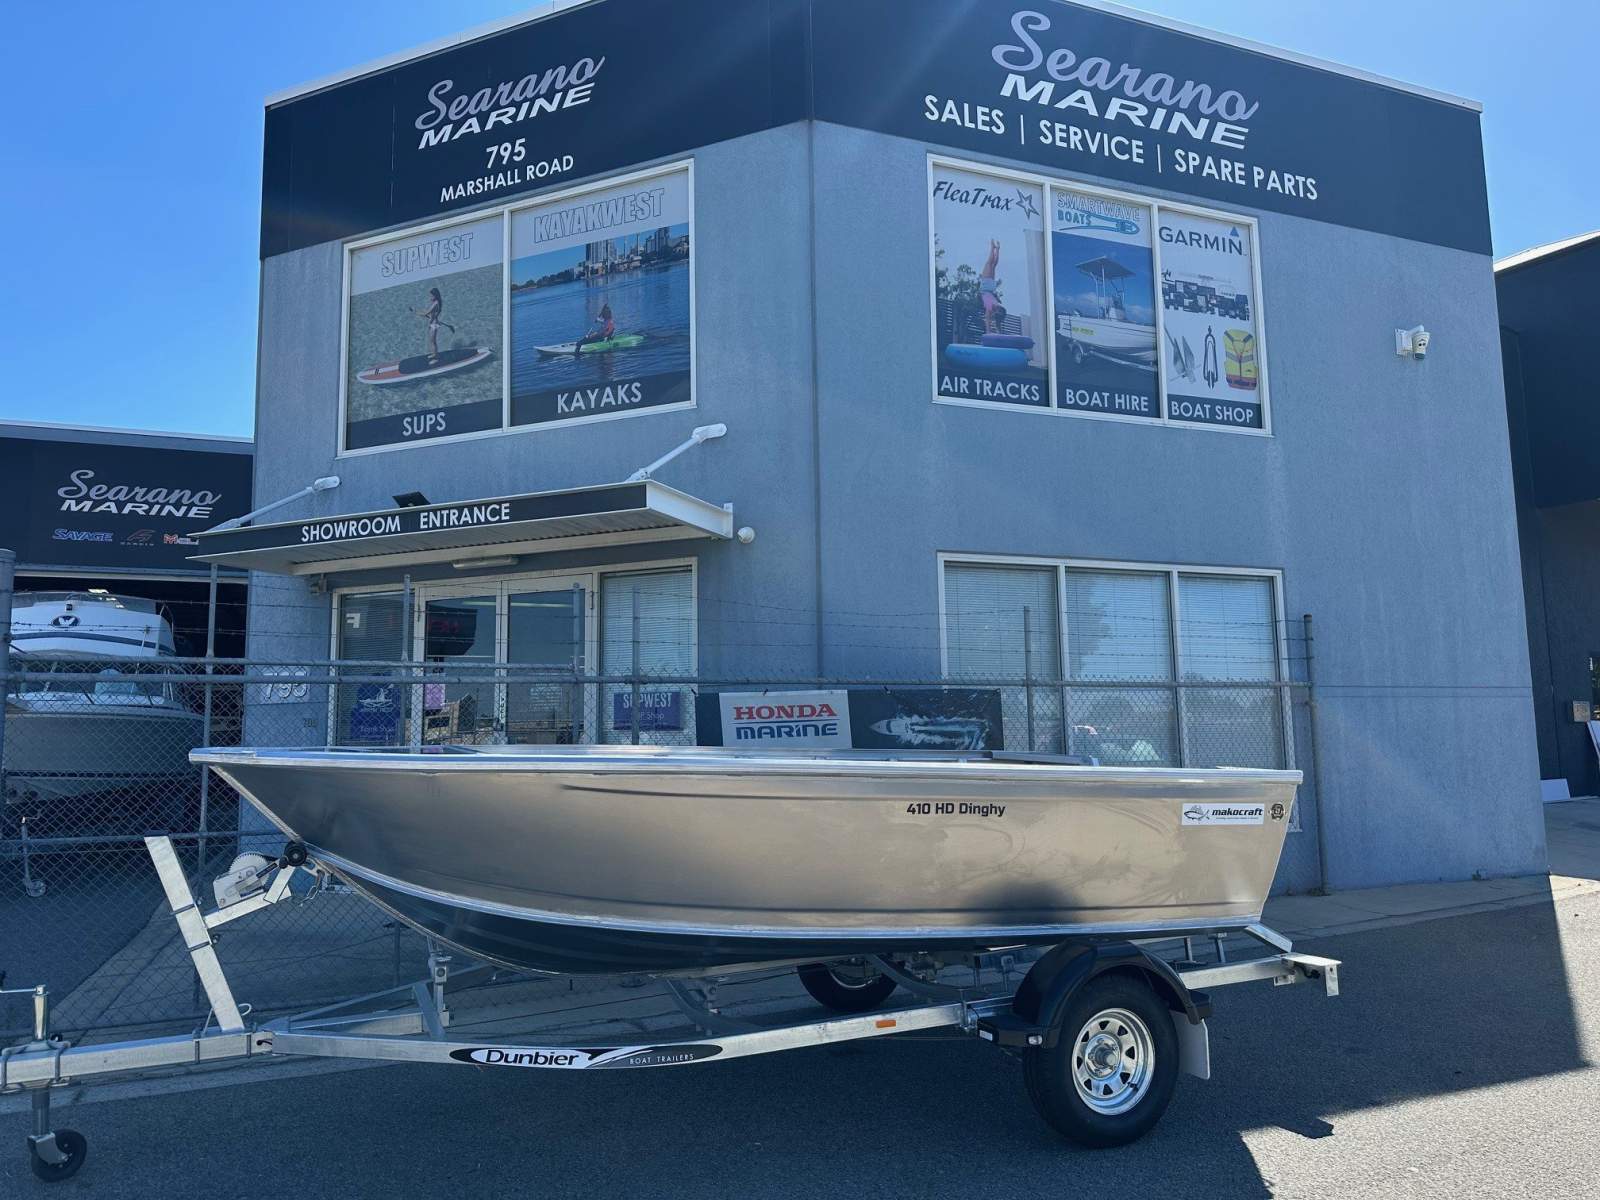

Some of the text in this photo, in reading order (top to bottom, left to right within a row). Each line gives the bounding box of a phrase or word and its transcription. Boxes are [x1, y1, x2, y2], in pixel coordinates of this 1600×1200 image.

[991, 10, 1259, 121] Searano
[415, 55, 605, 131] Searano
[418, 82, 595, 150] MARINE
[1000, 73, 1250, 150] MARINE
[486, 138, 527, 169] 795
[924, 94, 1318, 200] SALES SERVICE SPARE PARTS
[440, 154, 574, 202] MARSHALL ROAD
[933, 181, 1014, 211] FleaTrax
[1057, 191, 1141, 219] SMARTWAVE
[533, 188, 665, 244] KAYAKWEST
[1058, 209, 1092, 226] BOATS
[381, 232, 474, 278] SUPWEST
[1159, 226, 1243, 256] GARMIN
[557, 382, 642, 414] KAYAKS
[941, 375, 1040, 402] AIR TRACKS
[1066, 389, 1149, 413] BOAT HIRE
[402, 411, 446, 437] SUPS
[1171, 401, 1254, 423] BOAT SHOP
[57, 470, 222, 505] Searano
[60, 499, 213, 518] MARINE
[301, 503, 510, 543] SHOWROOM ENTRANCE
[52, 528, 114, 542] SAVAGE
[734, 703, 837, 720] HONDA
[736, 722, 838, 740] MARINE
[906, 803, 1006, 819] 410 HD Dinghy
[1212, 808, 1263, 816] makocraft
[486, 1050, 579, 1066] Dunbier
[630, 1053, 694, 1065] BOAT TRAILERS
